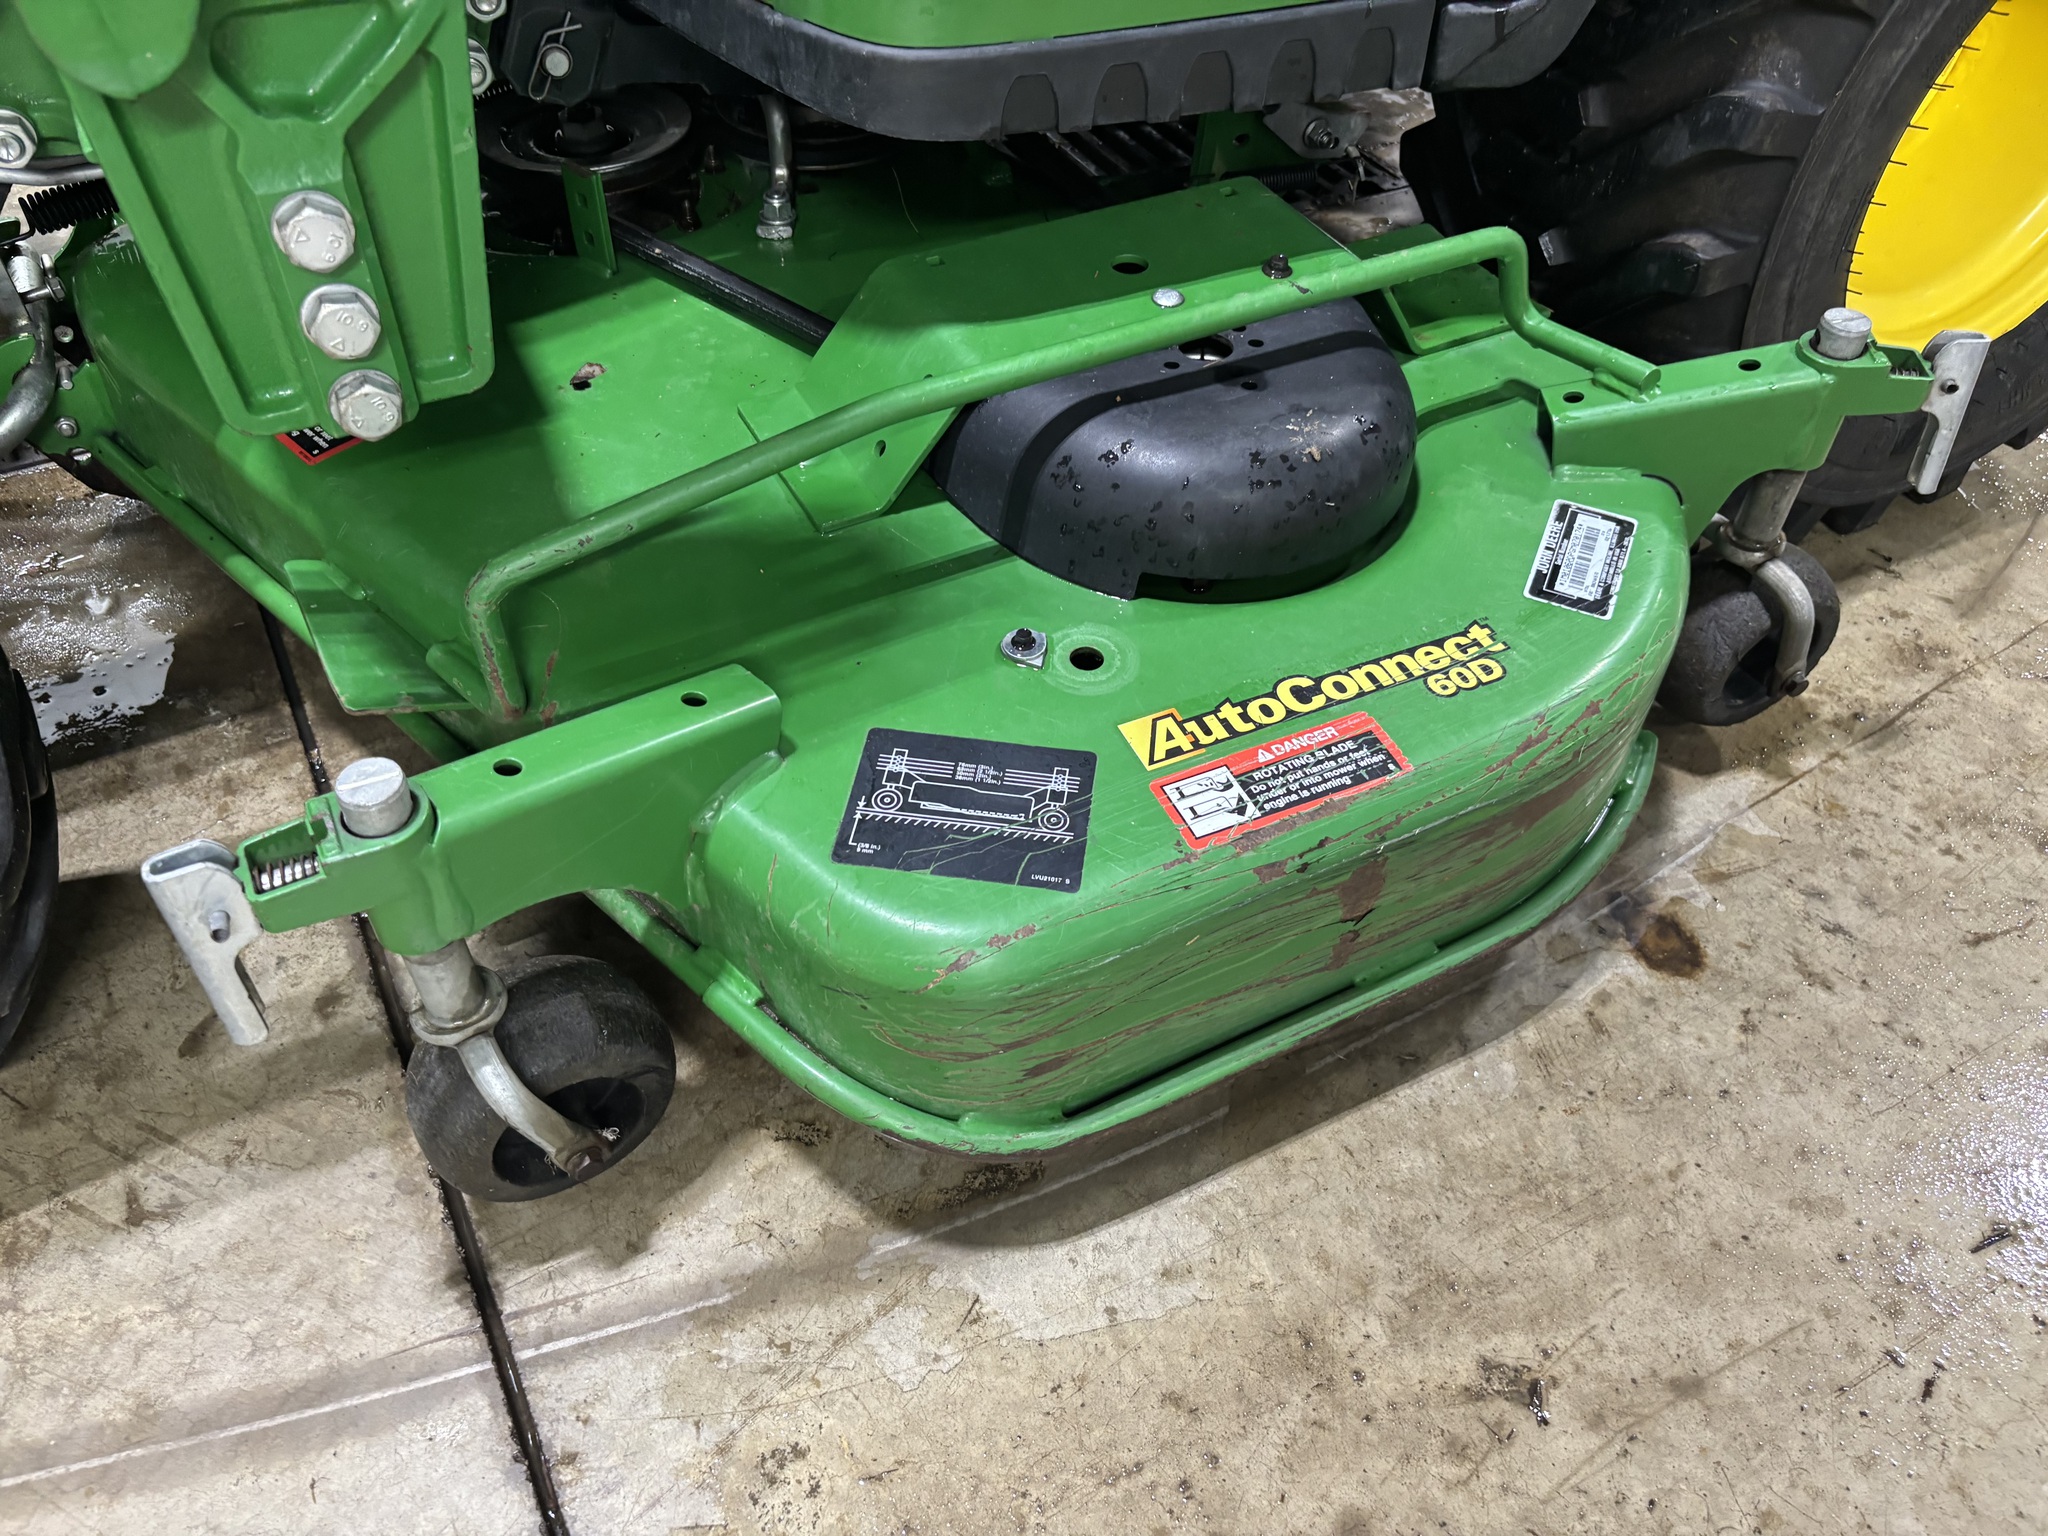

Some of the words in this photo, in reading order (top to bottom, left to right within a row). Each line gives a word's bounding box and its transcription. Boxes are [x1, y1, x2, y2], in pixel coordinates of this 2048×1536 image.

[1544, 519, 1563, 547] DEERE
[1536, 549, 1553, 573] JOHN
[1154, 623, 1506, 762] AutoConnect
[1426, 657, 1504, 695] 60D
[1270, 726, 1339, 756] DANGER
[1251, 782, 1267, 794] Do
[1268, 775, 1285, 788] not
[1287, 770, 1305, 783] put
[1305, 761, 1337, 775] hands
[1336, 755, 1349, 764] or
[1349, 748, 1372, 760] feet
[1252, 754, 1315, 782] ROTATING
[1315, 740, 1358, 760] BLADE
[1257, 786, 1287, 802] under
[1289, 782, 1301, 791] or
[1301, 774, 1323, 787] into
[1323, 763, 1357, 779] mower
[1357, 753, 1386, 767] when
[1263, 794, 1299, 811] engine
[1299, 789, 1310, 798] is
[1310, 776, 1352, 795] running
